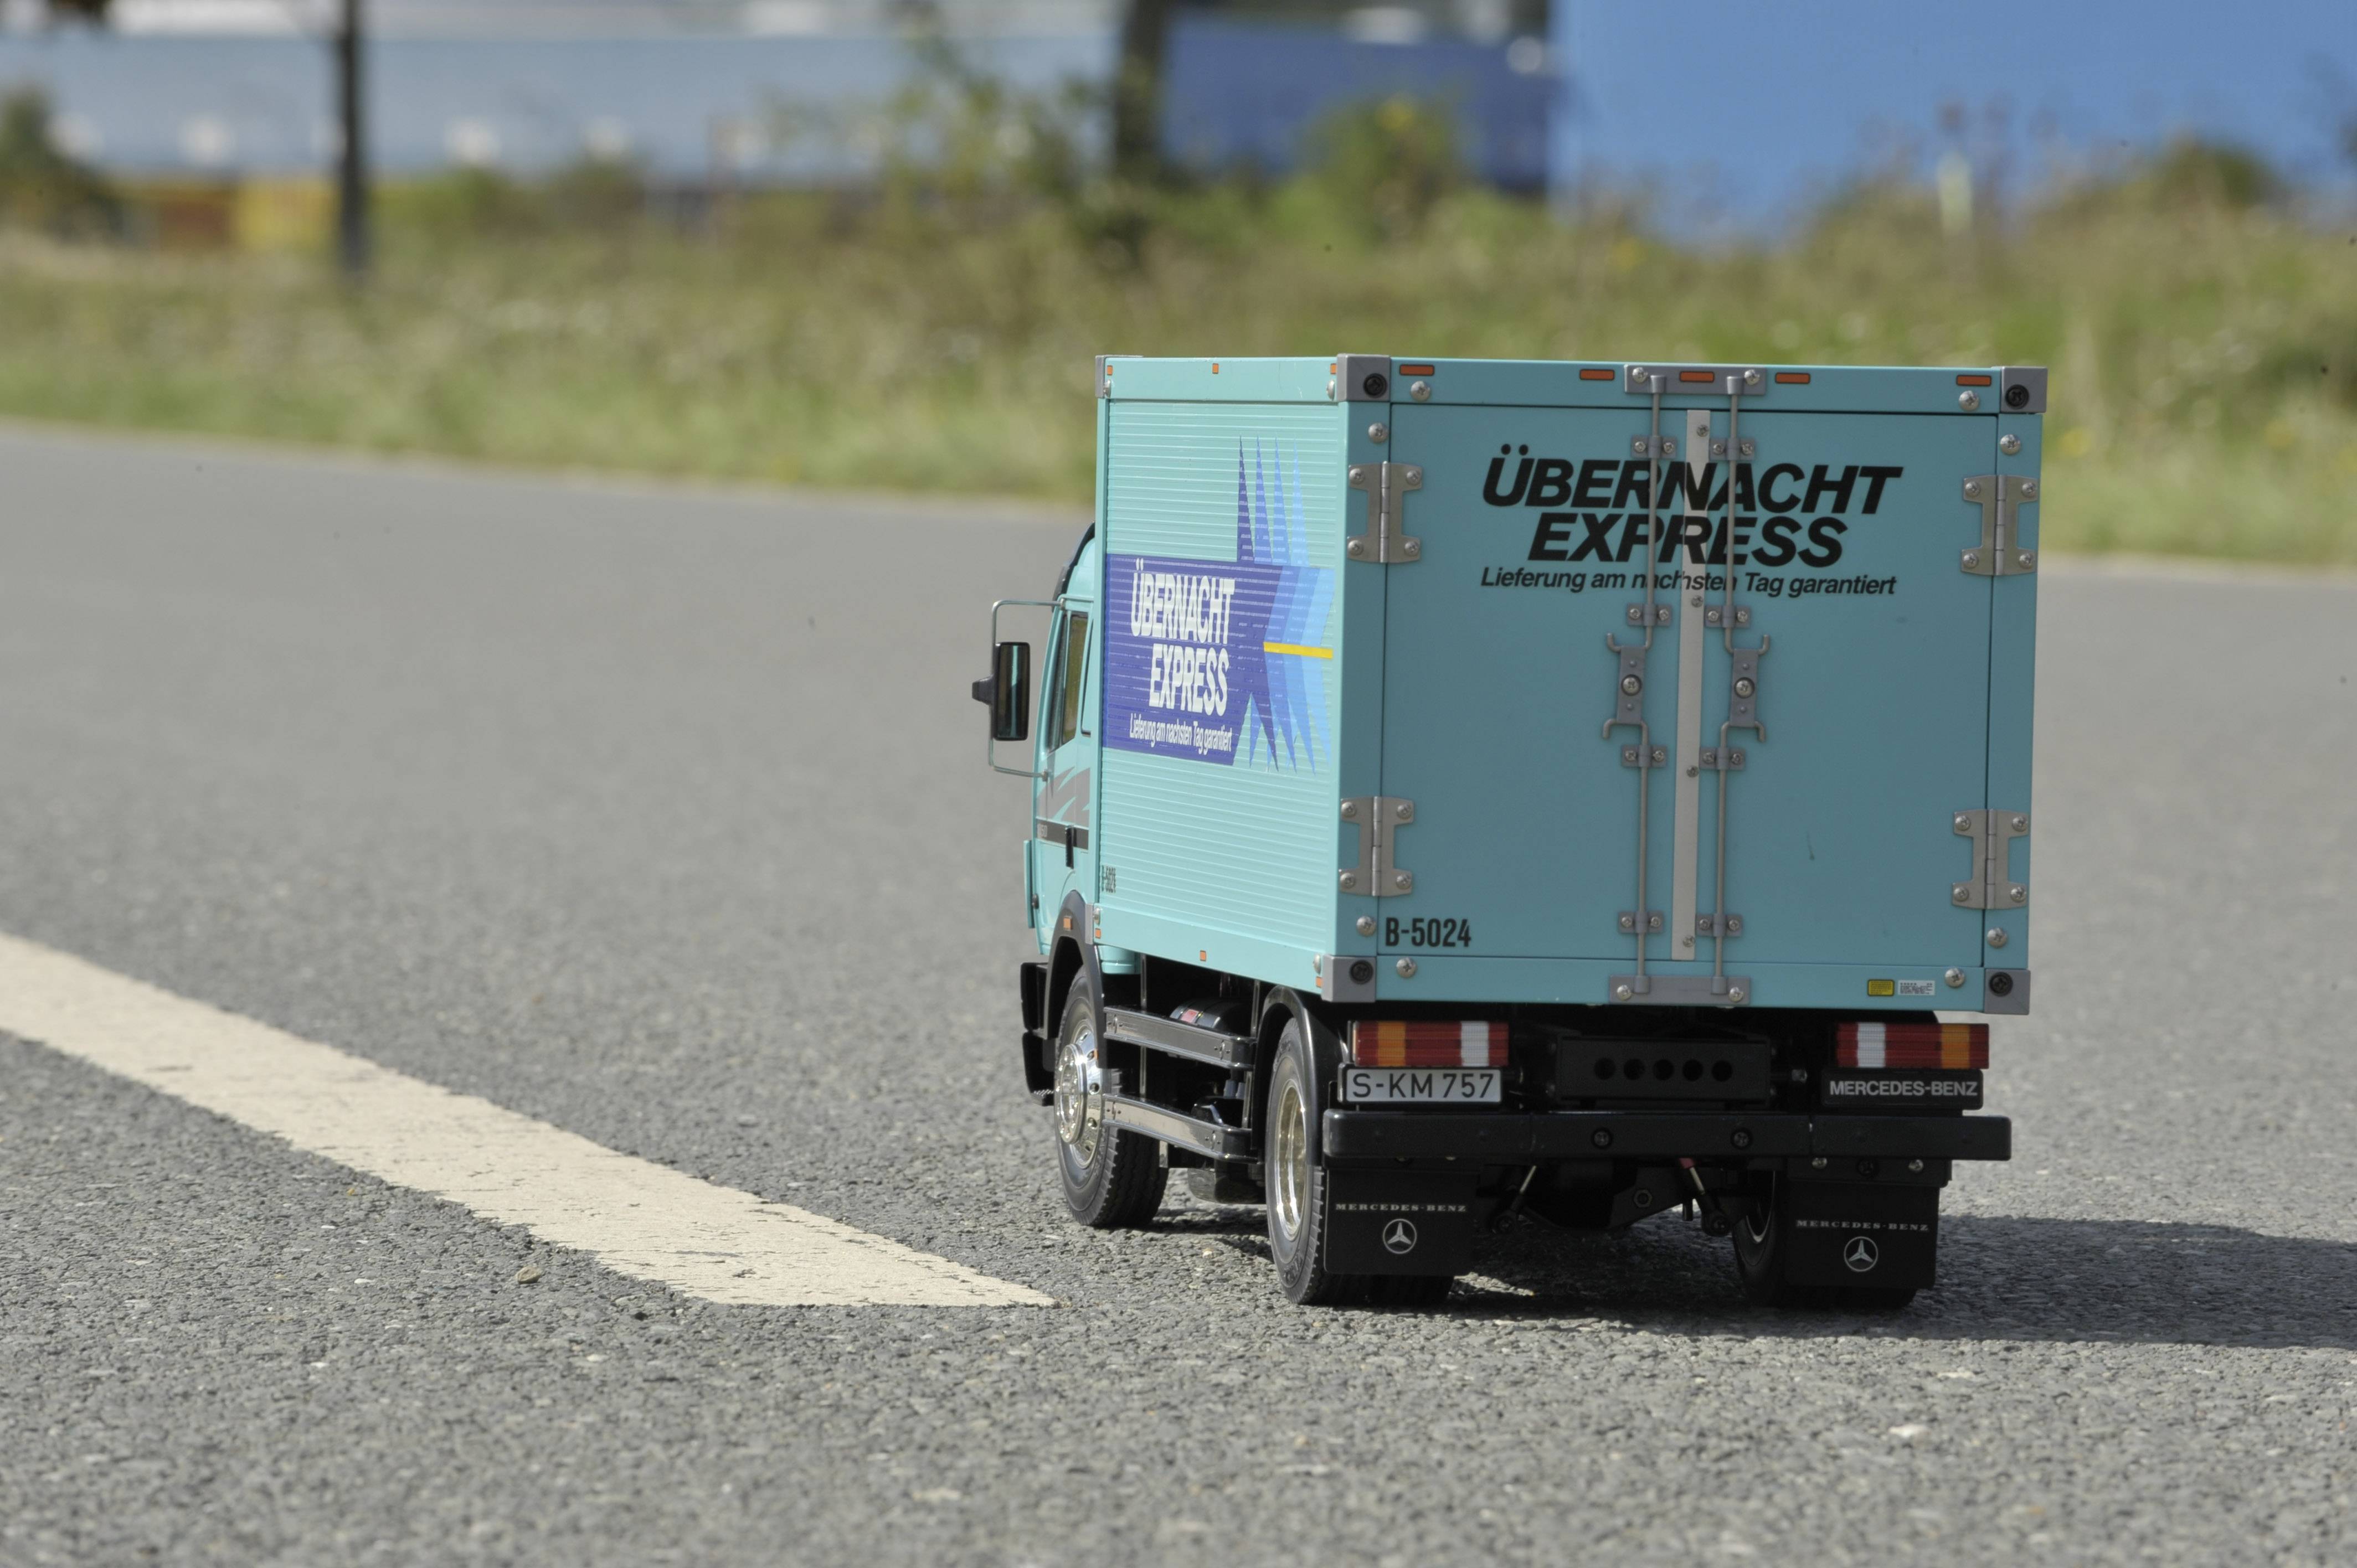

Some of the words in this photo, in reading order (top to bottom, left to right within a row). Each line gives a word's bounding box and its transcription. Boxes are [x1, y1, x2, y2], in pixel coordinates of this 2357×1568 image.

[1482, 443, 1903, 514] ÜBERNACHT
[1527, 513, 1848, 568] EXPRESS
[1480, 567, 1586, 593] Lieferung
[1591, 571, 1626, 589] am
[1744, 572, 1784, 597] Tag
[1788, 575, 1896, 598] garantiert
[1131, 558, 1236, 644] ÜBERNACHT
[1149, 643, 1229, 716] EXPRESS
[1130, 713, 1156, 747] Lieferung
[1156, 721, 1166, 741] am
[1193, 721, 1204, 755] Tag
[1203, 725, 1232, 755] garantiert
[1385, 917, 1471, 947] B-5024
[1352, 1073, 1433, 1098] S-KM
[1443, 1073, 1494, 1099] 757
[1830, 1081, 1978, 1096] MERCEDES-BENZ
[1335, 1203, 1467, 1212] MERCEDES-BENZ
[1796, 1220, 1929, 1231] MERCEDES-BENZ
